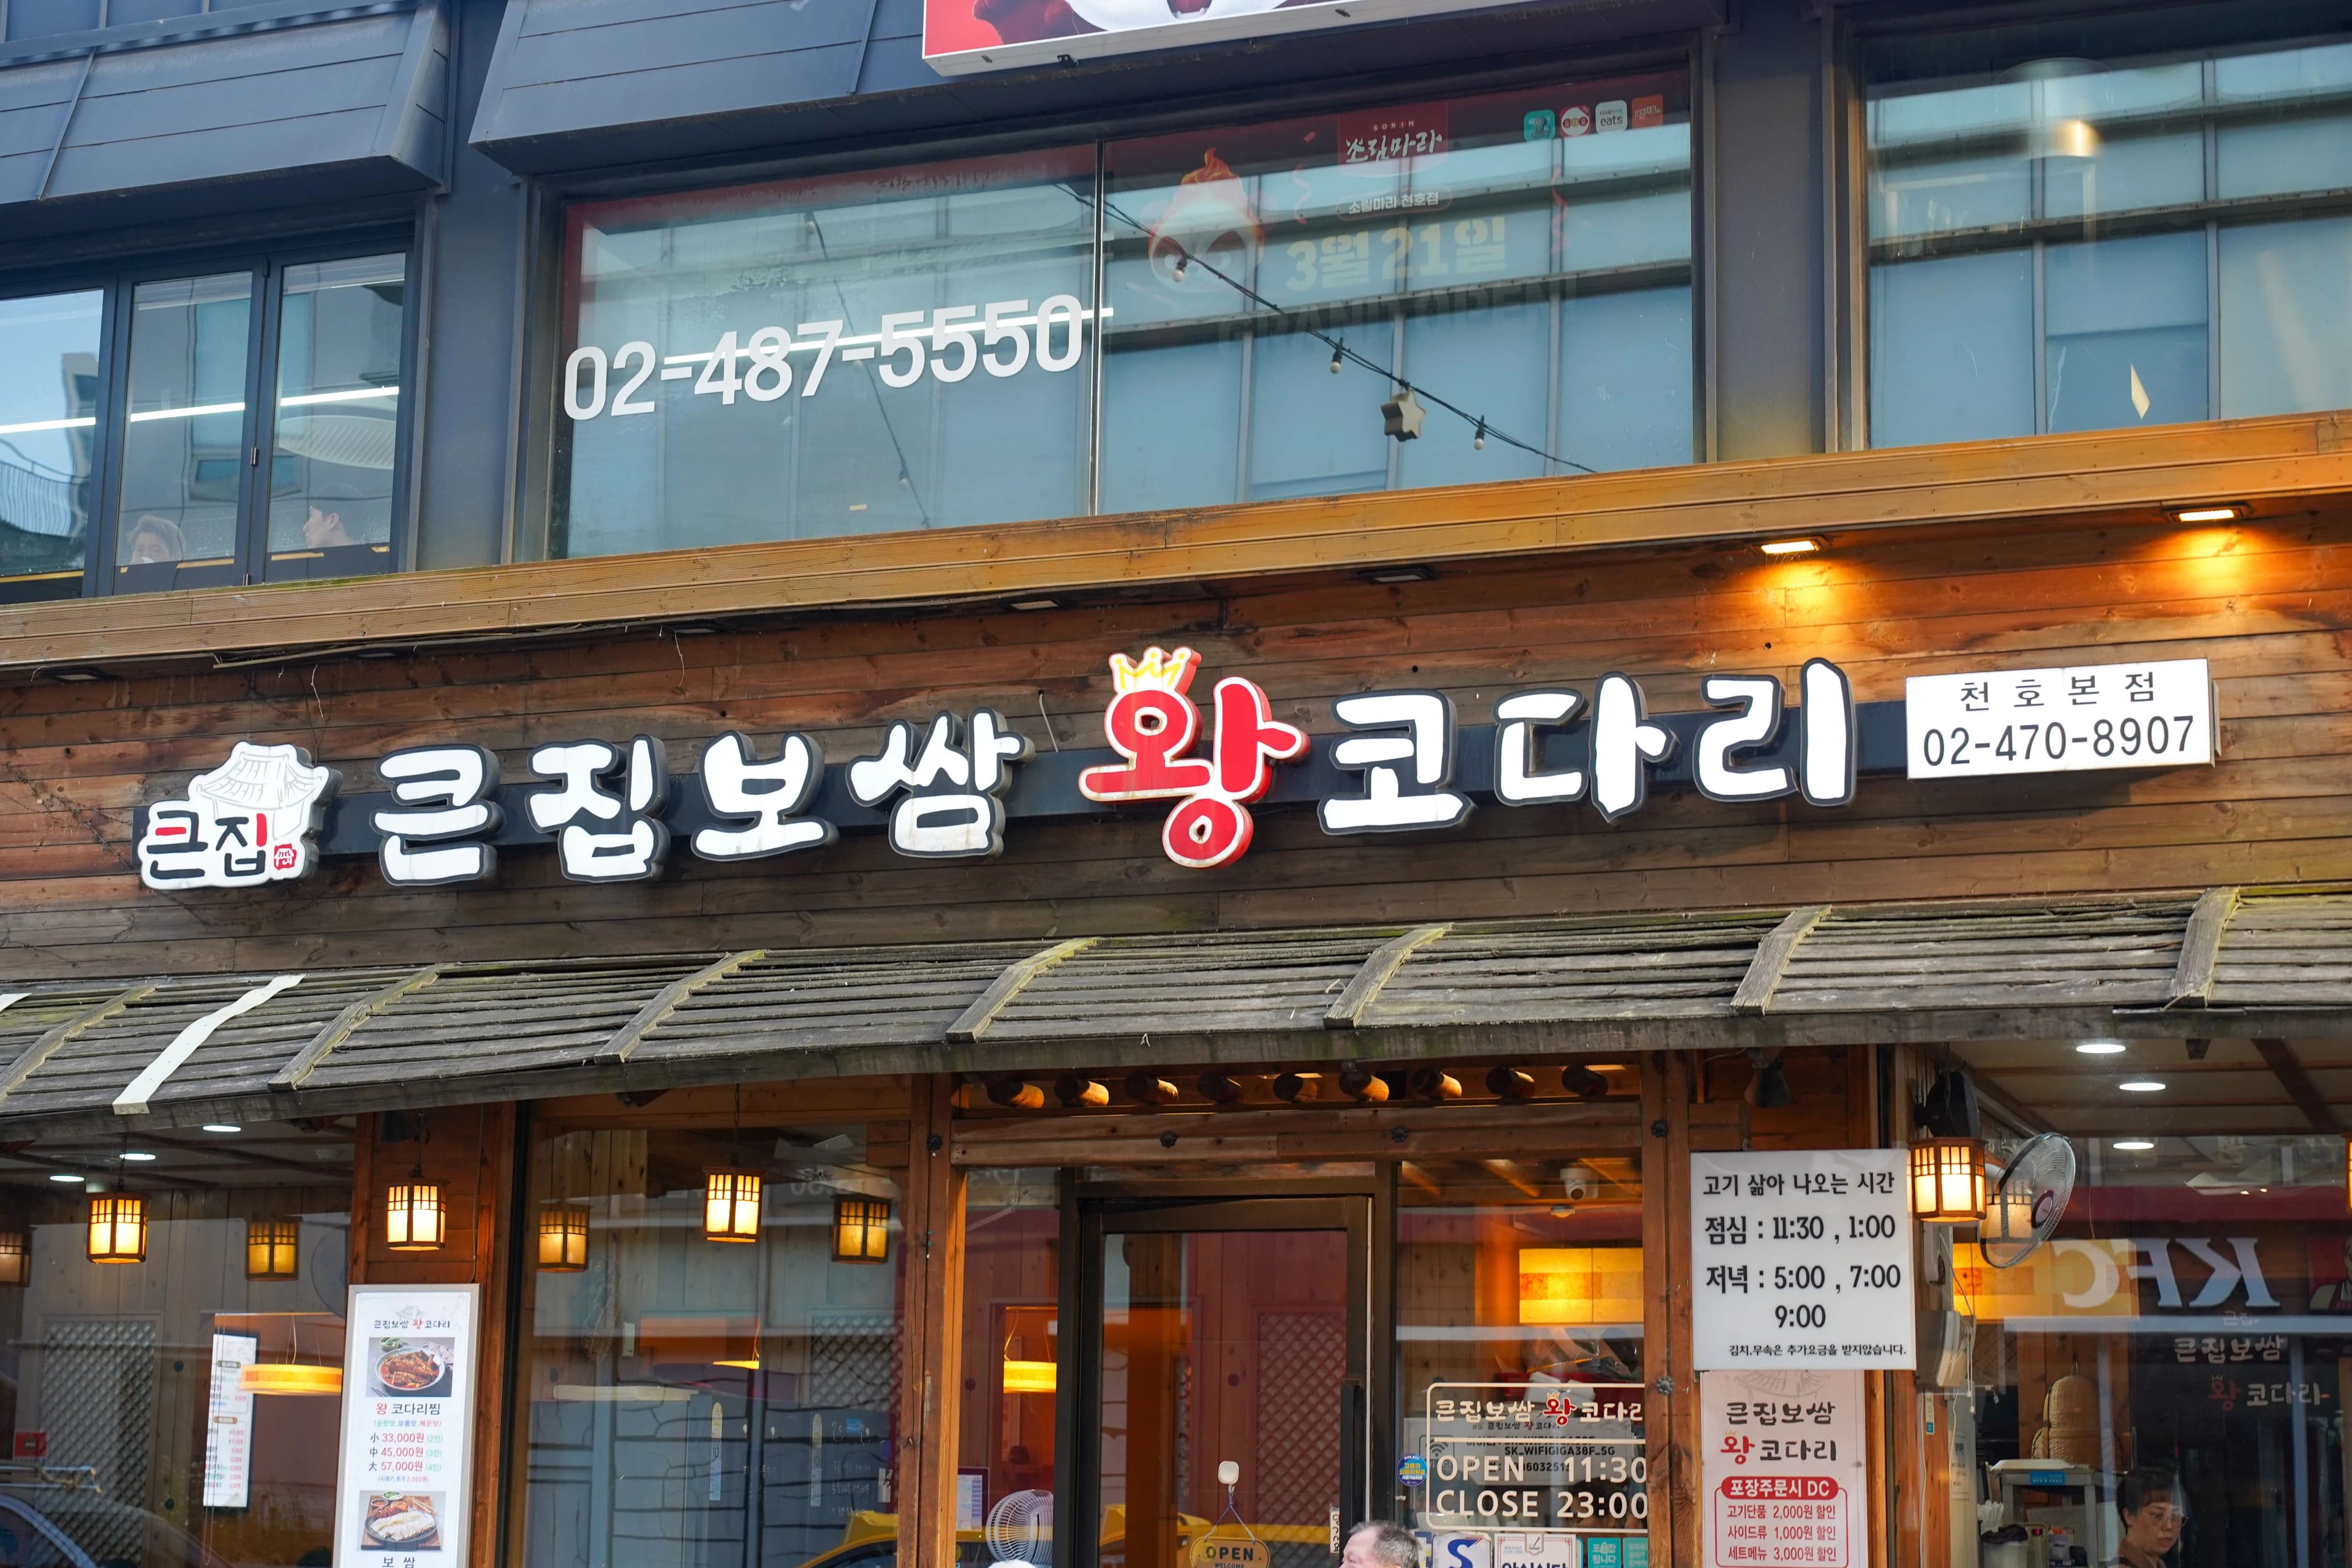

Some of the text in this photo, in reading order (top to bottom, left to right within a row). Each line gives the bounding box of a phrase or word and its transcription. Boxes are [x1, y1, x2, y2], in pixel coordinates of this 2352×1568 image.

[1373, 121, 1414, 131] SORIM
[1600, 115, 1623, 126] eats
[1349, 191, 1439, 214] 소림마라 천호점
[1286, 230, 1370, 292] 3월
[564, 294, 1084, 421] 02-487-5550
[1923, 715, 2194, 767] 02-470-8907
[370, 657, 1858, 886] 큰집보쌈 왕 코다리
[147, 810, 268, 880] 큰집
[1703, 1172, 1894, 1196] 고기 삶아 나오는 시간
[1705, 1215, 1747, 1245] 점심
[1773, 1215, 1824, 1240] 11:30
[1849, 1215, 1896, 1239] 1:00
[1706, 1264, 1748, 1294] 저녁
[1774, 1265, 1825, 1289] 5:00
[1850, 1264, 1901, 1289] 7:00
[374, 1319, 450, 1330] 큰집보쌈 왕 코다리
[1774, 1303, 1826, 1328] 9:00
[1786, 1344, 1837, 1356] 추가요금을
[1842, 1344, 1906, 1356] 받지않습니다.
[2174, 1335, 2285, 1364] 큰집보쌈
[2207, 1381, 2321, 1412] 왕 코다리
[375, 1403, 441, 1415] 왕 코다리찜
[1435, 1399, 1536, 1423] 큰집보쌈
[1542, 1396, 1577, 1427] 왕
[1726, 1401, 1836, 1426] 큰집보쌈
[370, 1433, 379, 1443] 小
[382, 1432, 424, 1444] 33,000원
[1720, 1435, 1837, 1464] 왕 코다리
[370, 1447, 378, 1457] 中
[381, 1447, 424, 1458] 45,000원
[1504, 1446, 1616, 1457] SK_WIFIGIGA38F_5G
[369, 1461, 377, 1471] 大
[381, 1461, 423, 1472] 57,000원
[1437, 1455, 1647, 1484] OPEN 11:30
[1730, 1479, 1830, 1498] 포장주문시 DC
[1436, 1489, 1648, 1519] CLOSE 23:00
[1727, 1505, 1836, 1520] 고기단품 2,000원 할인
[1727, 1525, 1836, 1540] 사이드류 1,000원 할인
[1206, 1545, 1254, 1561] OPEN
[1728, 1546, 1837, 1562] 세트메뉴 3,000원 할인
